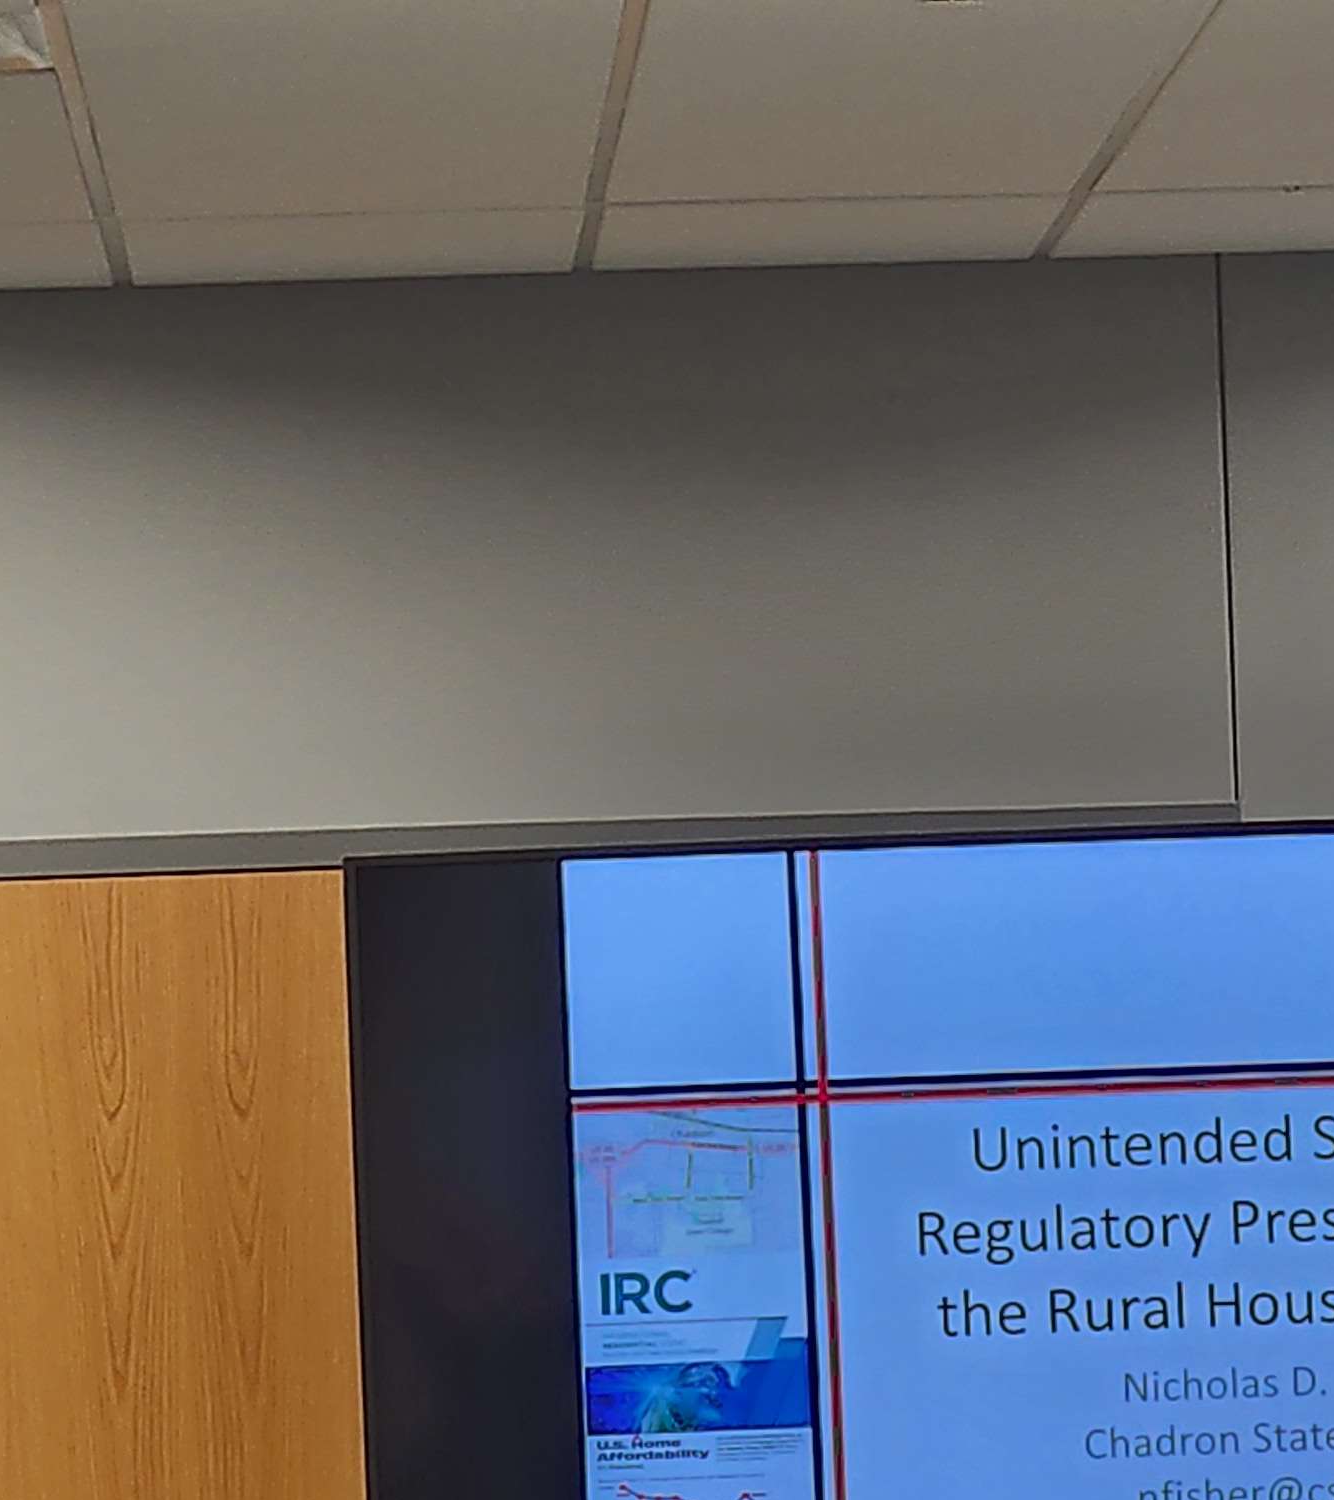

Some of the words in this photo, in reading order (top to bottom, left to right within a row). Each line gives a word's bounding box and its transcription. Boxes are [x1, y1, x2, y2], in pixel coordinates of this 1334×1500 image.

[972, 1114, 1293, 1172] Unintended
[917, 1203, 1212, 1266] Regulatory
[599, 1269, 694, 1316] IRC
[937, 1288, 1027, 1337] the
[1048, 1281, 1185, 1334] Rural
[1123, 1367, 1279, 1403] Nicholas
[1292, 1366, 1327, 1397] D.
[596, 1440, 628, 1451] U.S.
[631, 1438, 681, 1449] Home
[596, 1448, 710, 1462] Affordability
[1085, 1424, 1240, 1459] Chadron
